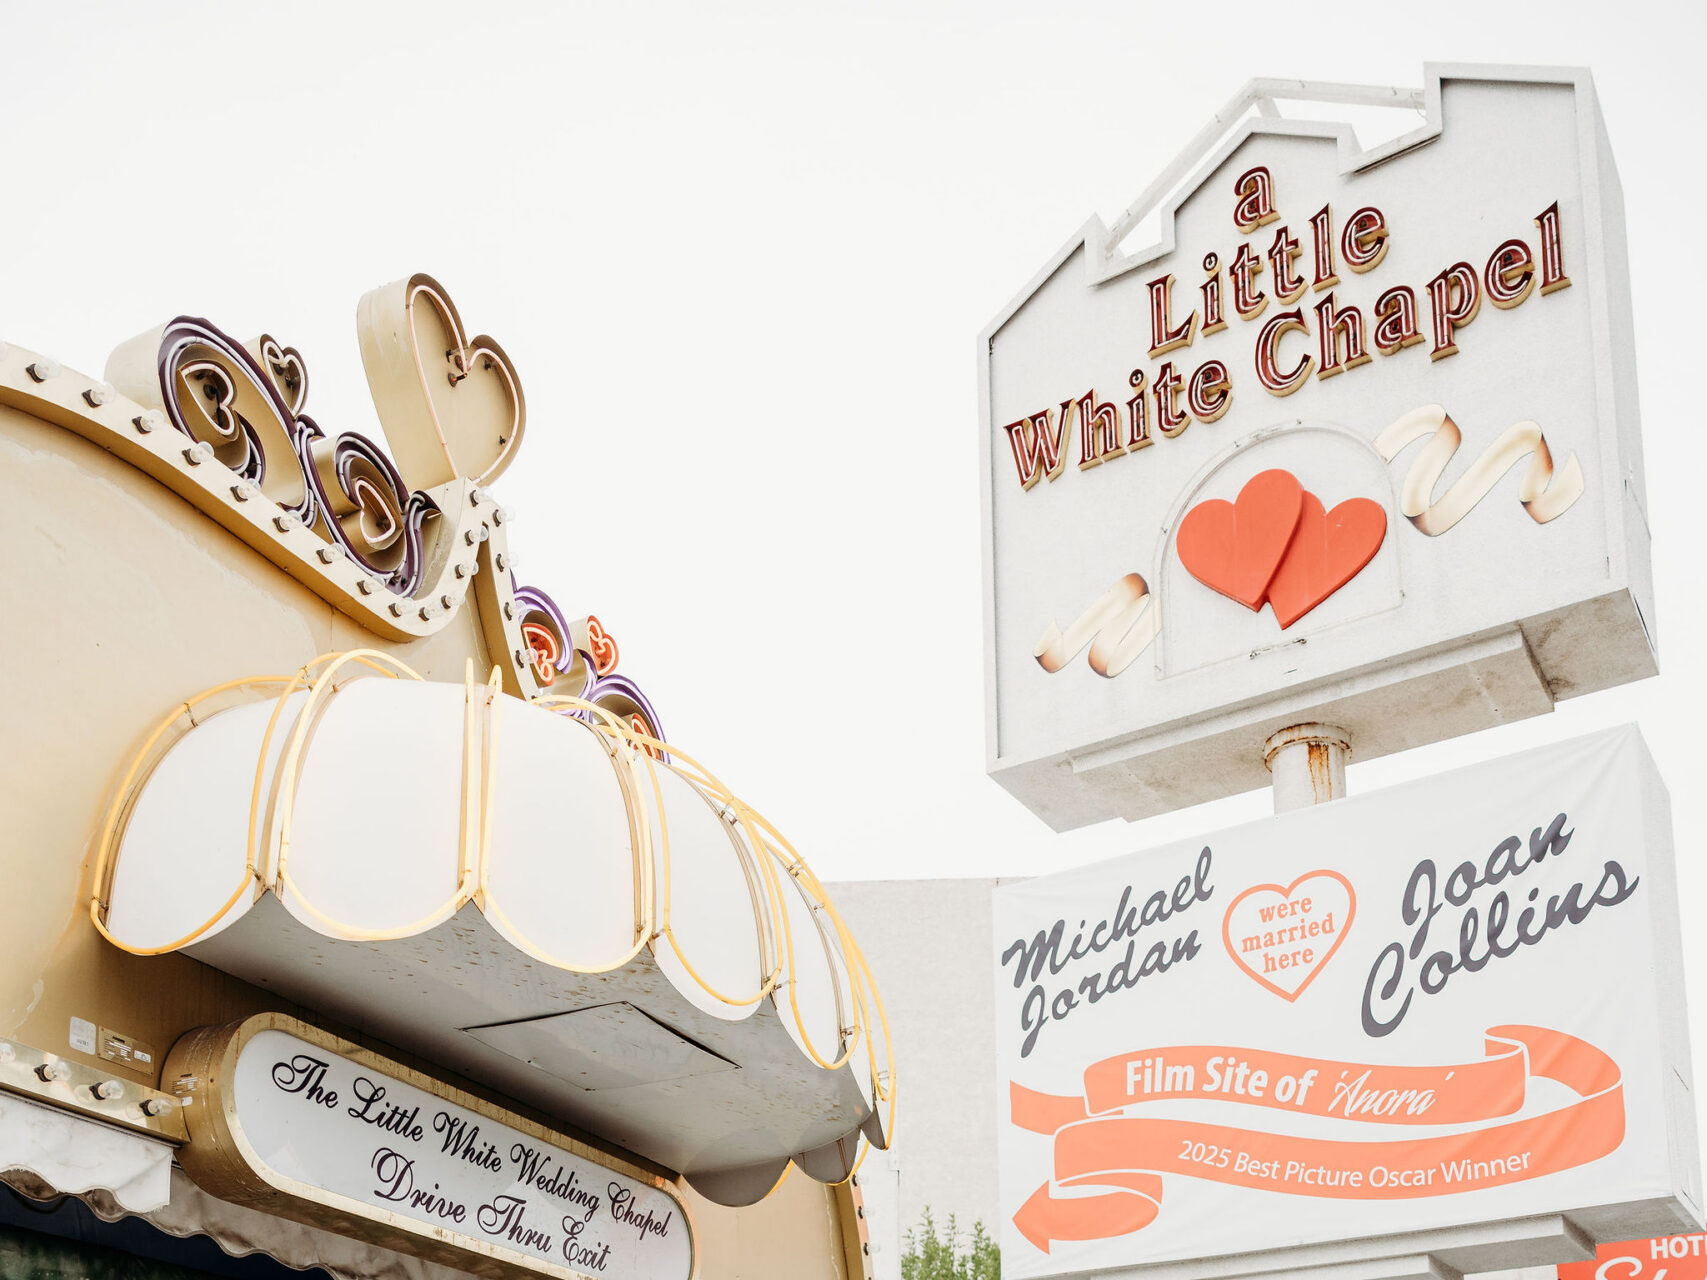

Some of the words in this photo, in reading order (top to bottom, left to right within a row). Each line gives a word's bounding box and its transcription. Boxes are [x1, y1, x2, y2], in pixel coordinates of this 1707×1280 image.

[1233, 164, 1281, 235] a
[1146, 202, 1390, 359] Little
[1003, 359, 1234, 492] White
[1253, 200, 1571, 398] Chapel
[1002, 845, 1215, 988] Michael
[1241, 912, 1336, 953] married
[1258, 897, 1312, 925] were
[1402, 812, 1575, 960] Joan
[1020, 930, 1202, 1058] Jordan
[1262, 946, 1314, 974] here
[1361, 860, 1640, 1038] Collins
[1126, 1056, 1195, 1096] Film
[1202, 1056, 1269, 1097] Site
[1274, 1069, 1319, 1106] of
[272, 1054, 339, 1109] The
[348, 1076, 424, 1142] Little
[433, 1111, 502, 1173] White
[510, 1143, 600, 1223] Wedding
[607, 1182, 673, 1240] Chapel
[371, 1147, 467, 1223] Drive
[477, 1195, 552, 1253] Thru
[561, 1215, 612, 1272] Exit
[1178, 1140, 1232, 1168] 2025
[1233, 1151, 1281, 1180] Best
[1284, 1160, 1363, 1187] Picture
[1369, 1166, 1437, 1188] Oscar
[1440, 1151, 1531, 1183] Winner
[1650, 1235, 1707, 1260] HOT
